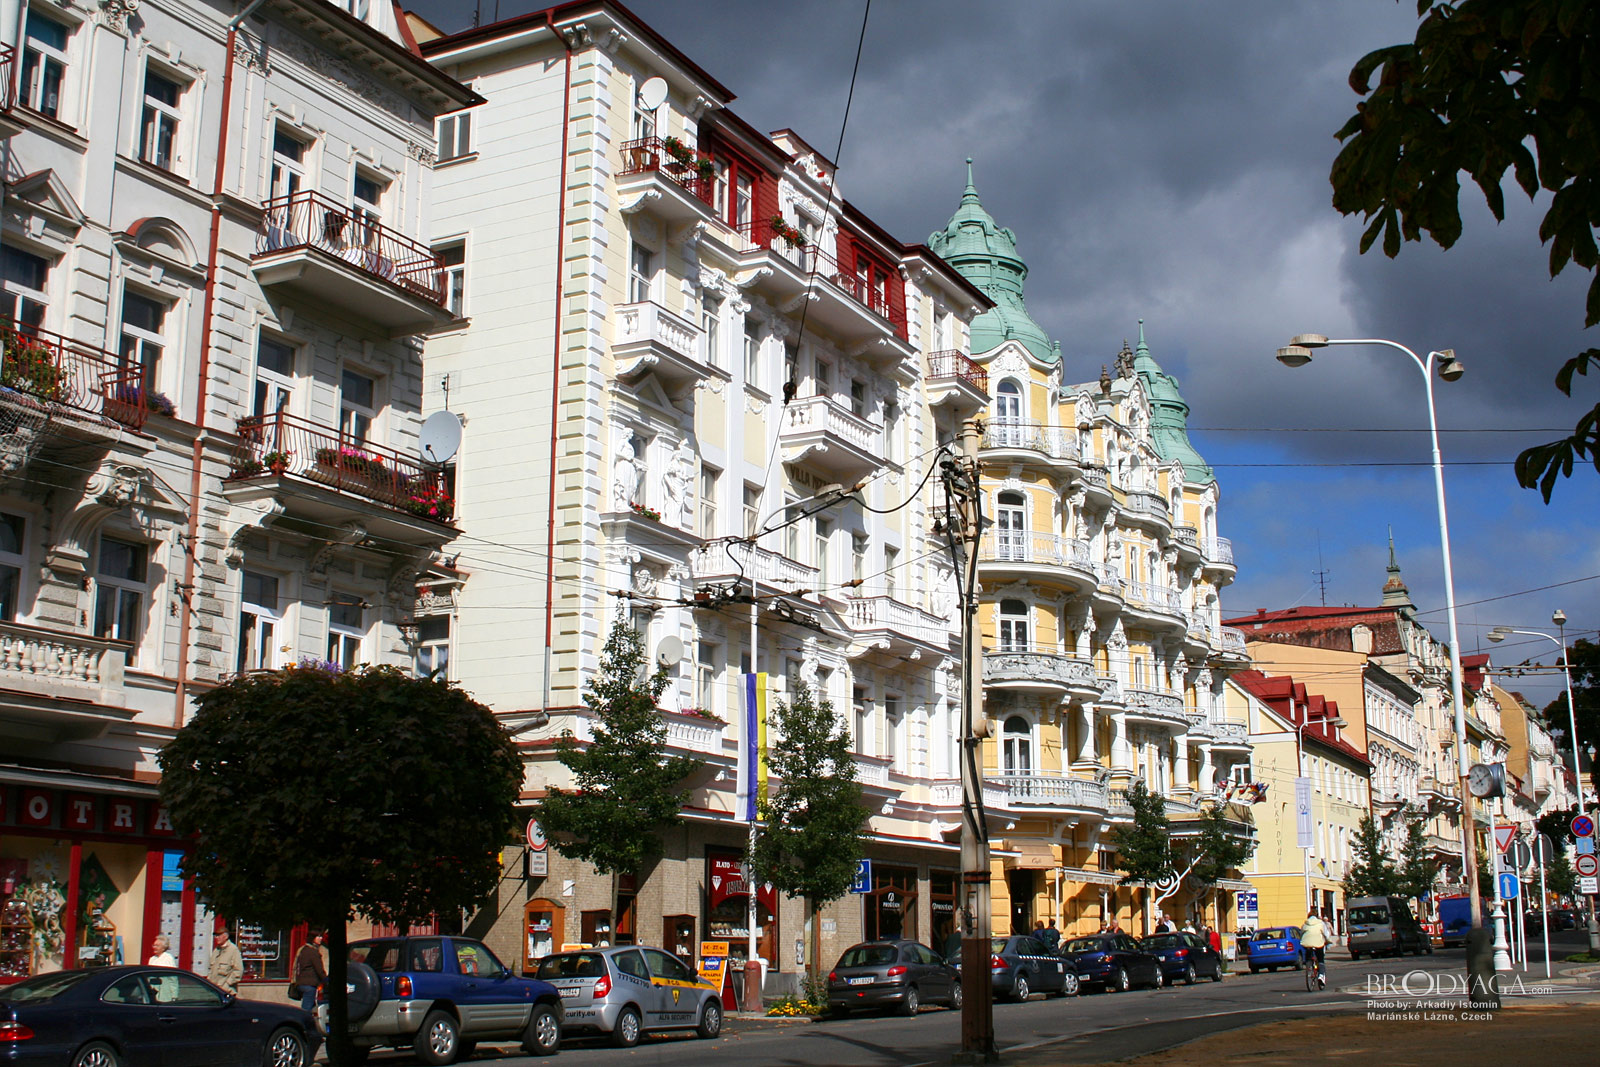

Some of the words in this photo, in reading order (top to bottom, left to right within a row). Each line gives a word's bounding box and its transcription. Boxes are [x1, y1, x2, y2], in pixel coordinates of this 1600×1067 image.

[790, 464, 811, 487] VILLA
[0, 794, 174, 831] OTRA
[715, 860, 731, 868] ZLATO
[565, 1010, 596, 1019] curity.eu
